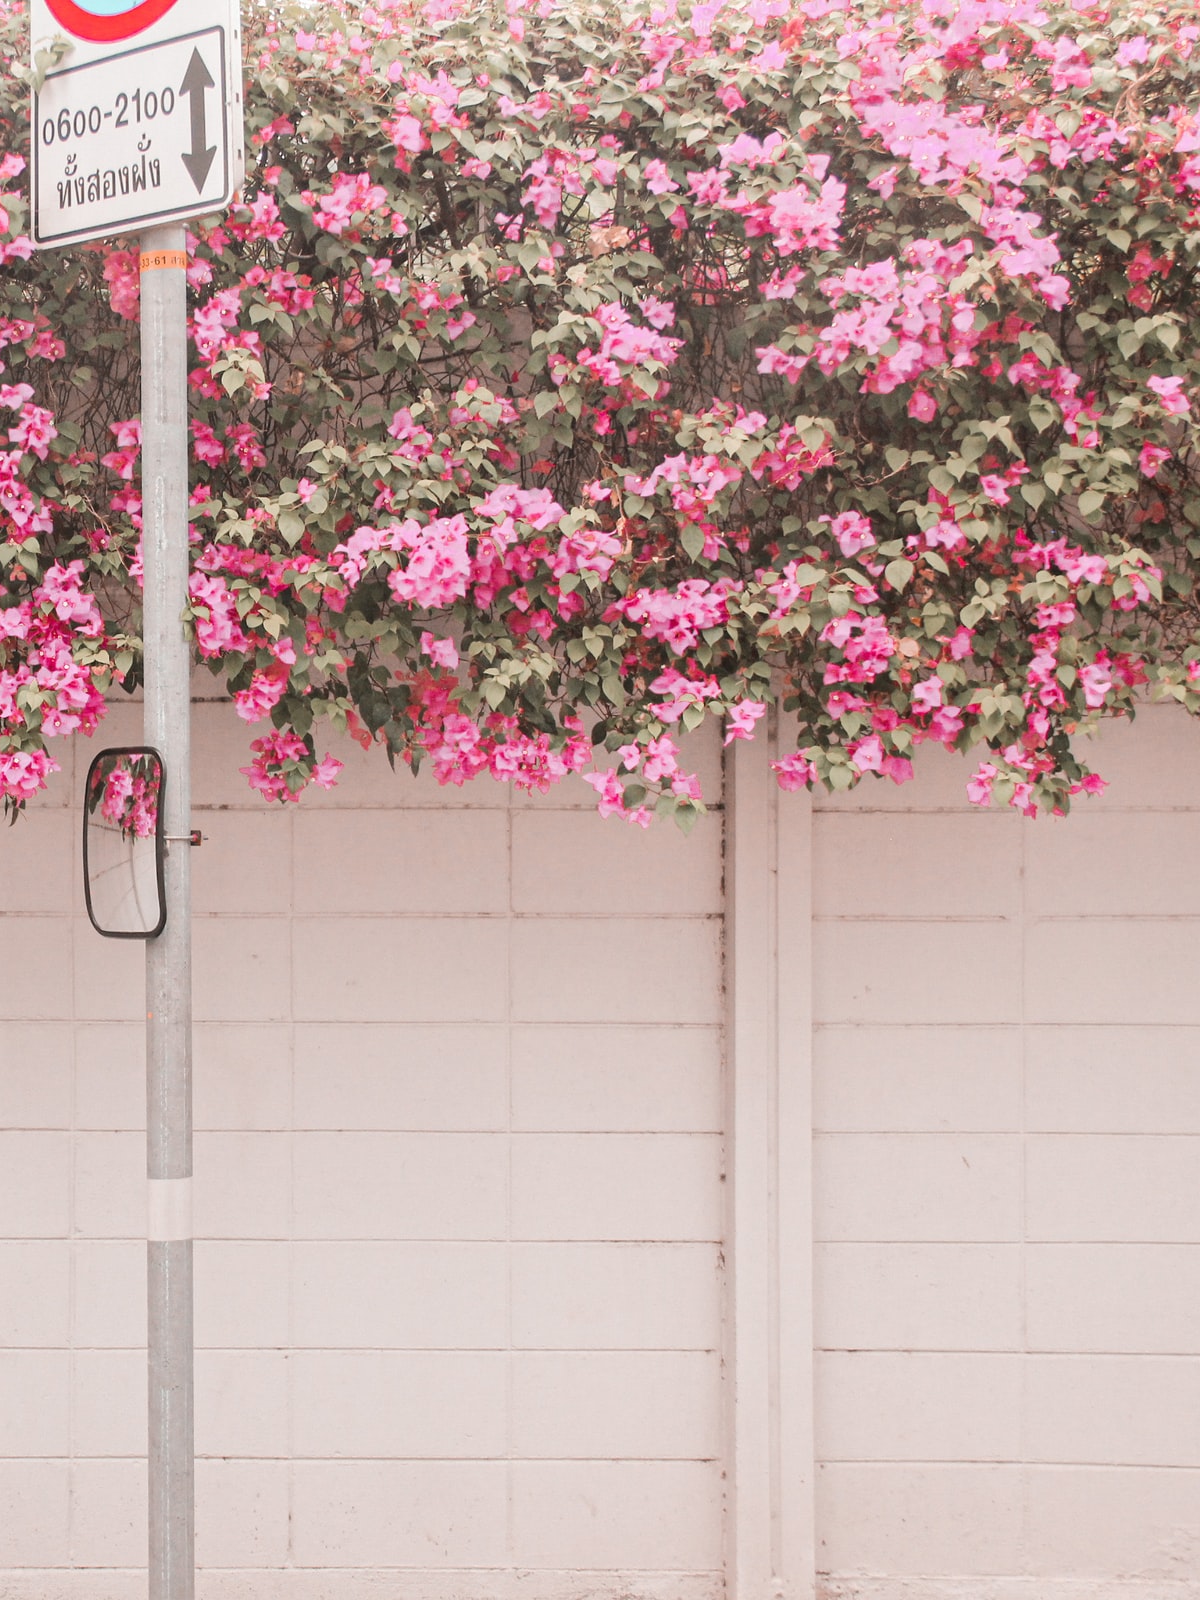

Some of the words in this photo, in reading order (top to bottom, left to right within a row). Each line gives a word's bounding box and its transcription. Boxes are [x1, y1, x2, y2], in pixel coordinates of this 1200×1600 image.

[42, 86, 175, 146] 0600-2100
[56, 132, 161, 210] ทั้งสองฝั่ง
